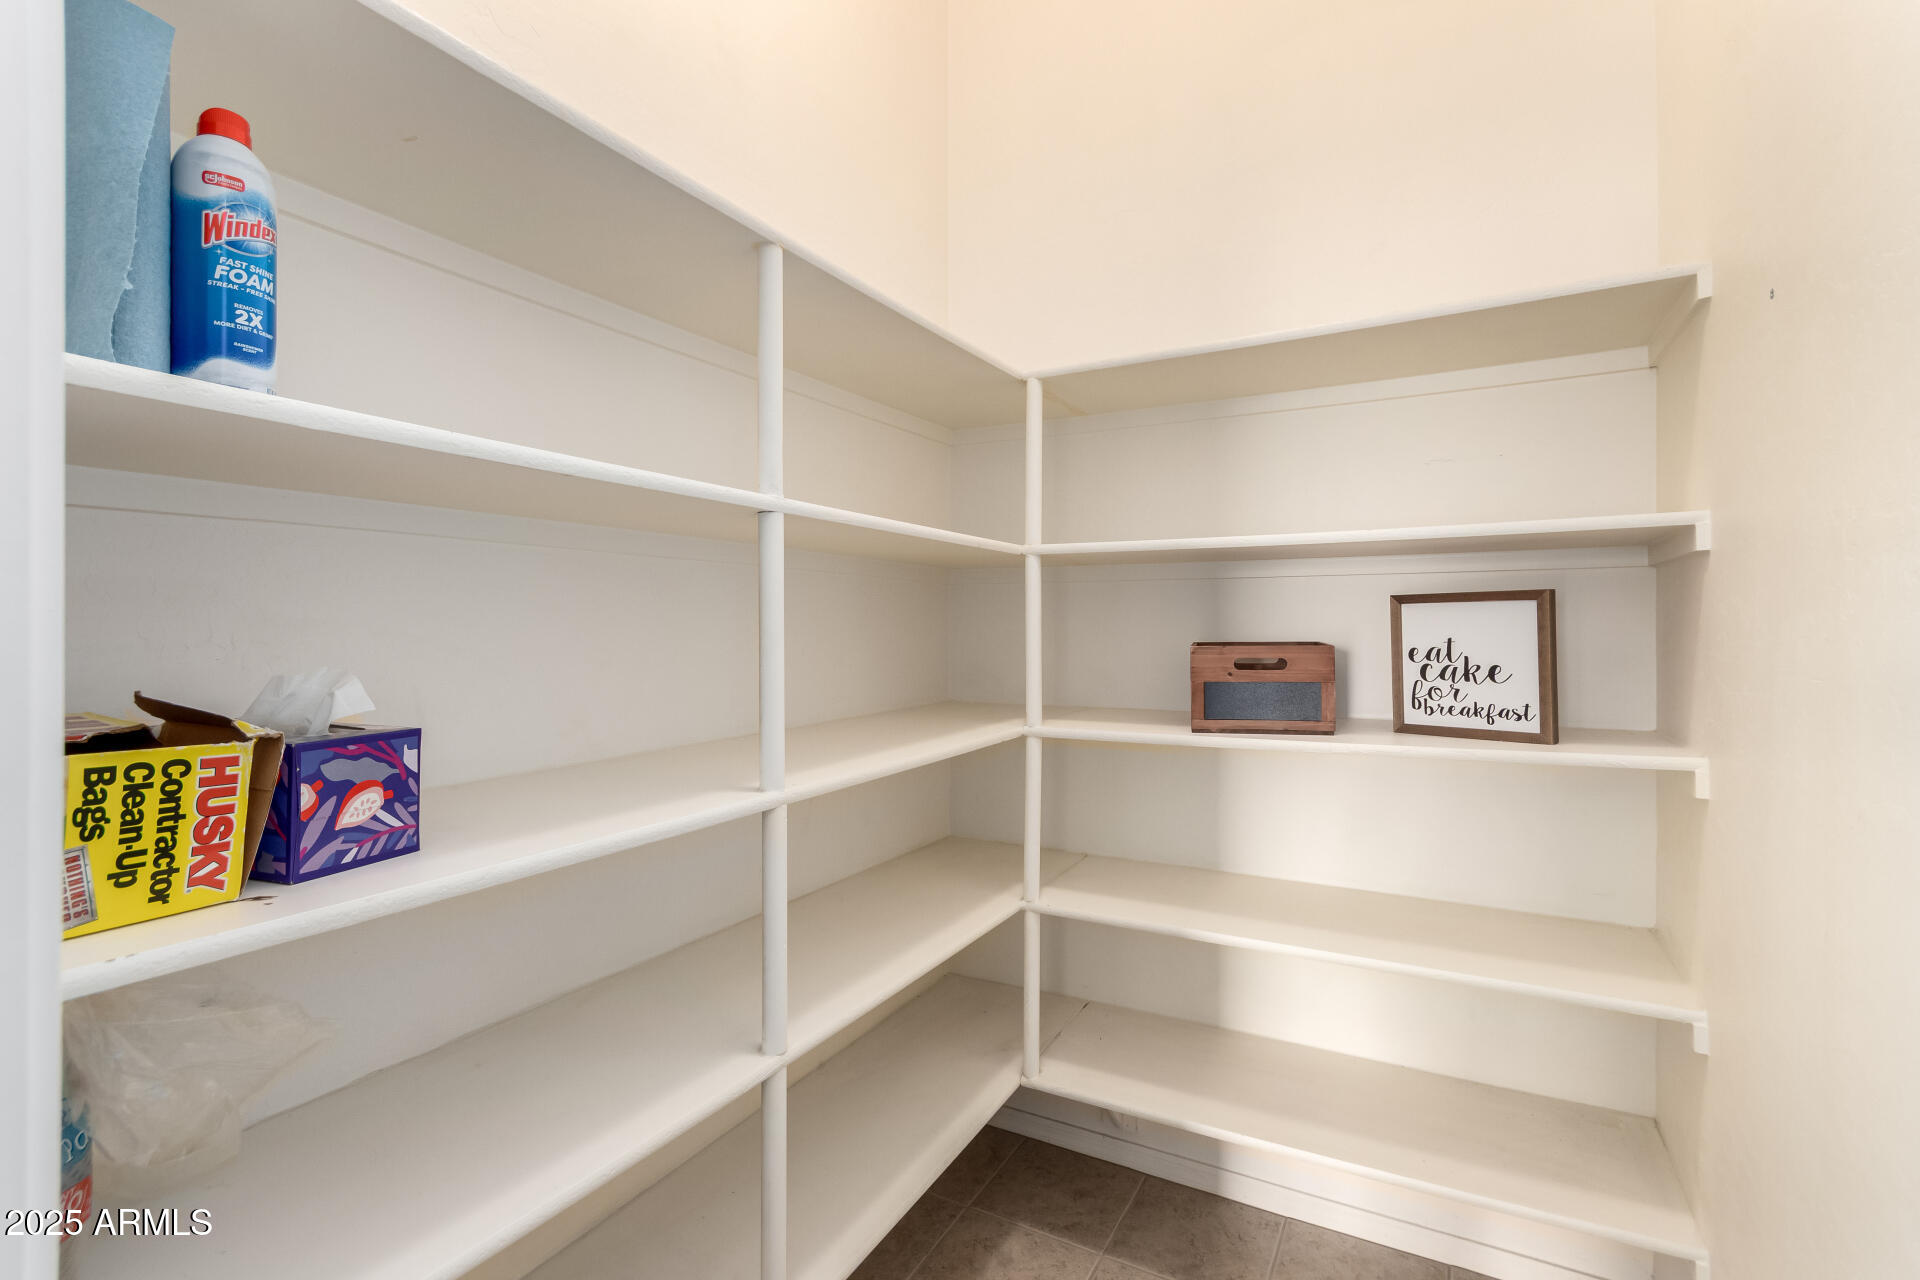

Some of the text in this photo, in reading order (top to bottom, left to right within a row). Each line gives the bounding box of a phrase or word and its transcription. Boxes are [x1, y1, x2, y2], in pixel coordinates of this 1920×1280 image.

[202, 209, 277, 247] Windex
[214, 264, 274, 296] FOAM
[219, 256, 274, 281] FAST SHINE
[207, 279, 239, 291] STREAK
[246, 287, 264, 298] FREE
[233, 302, 264, 316] REMOVES
[234, 309, 263, 330] 2X
[213, 319, 235, 329] MORE
[1408, 637, 1463, 663] eat
[1420, 656, 1512, 685] cake
[1411, 680, 1468, 710] for
[1424, 698, 1536, 725] breakfast
[73, 765, 117, 842] Bags
[148, 758, 192, 905] Contractor
[186, 754, 242, 892] HUSKY
[64, 854, 89, 919] NOTHING'S
